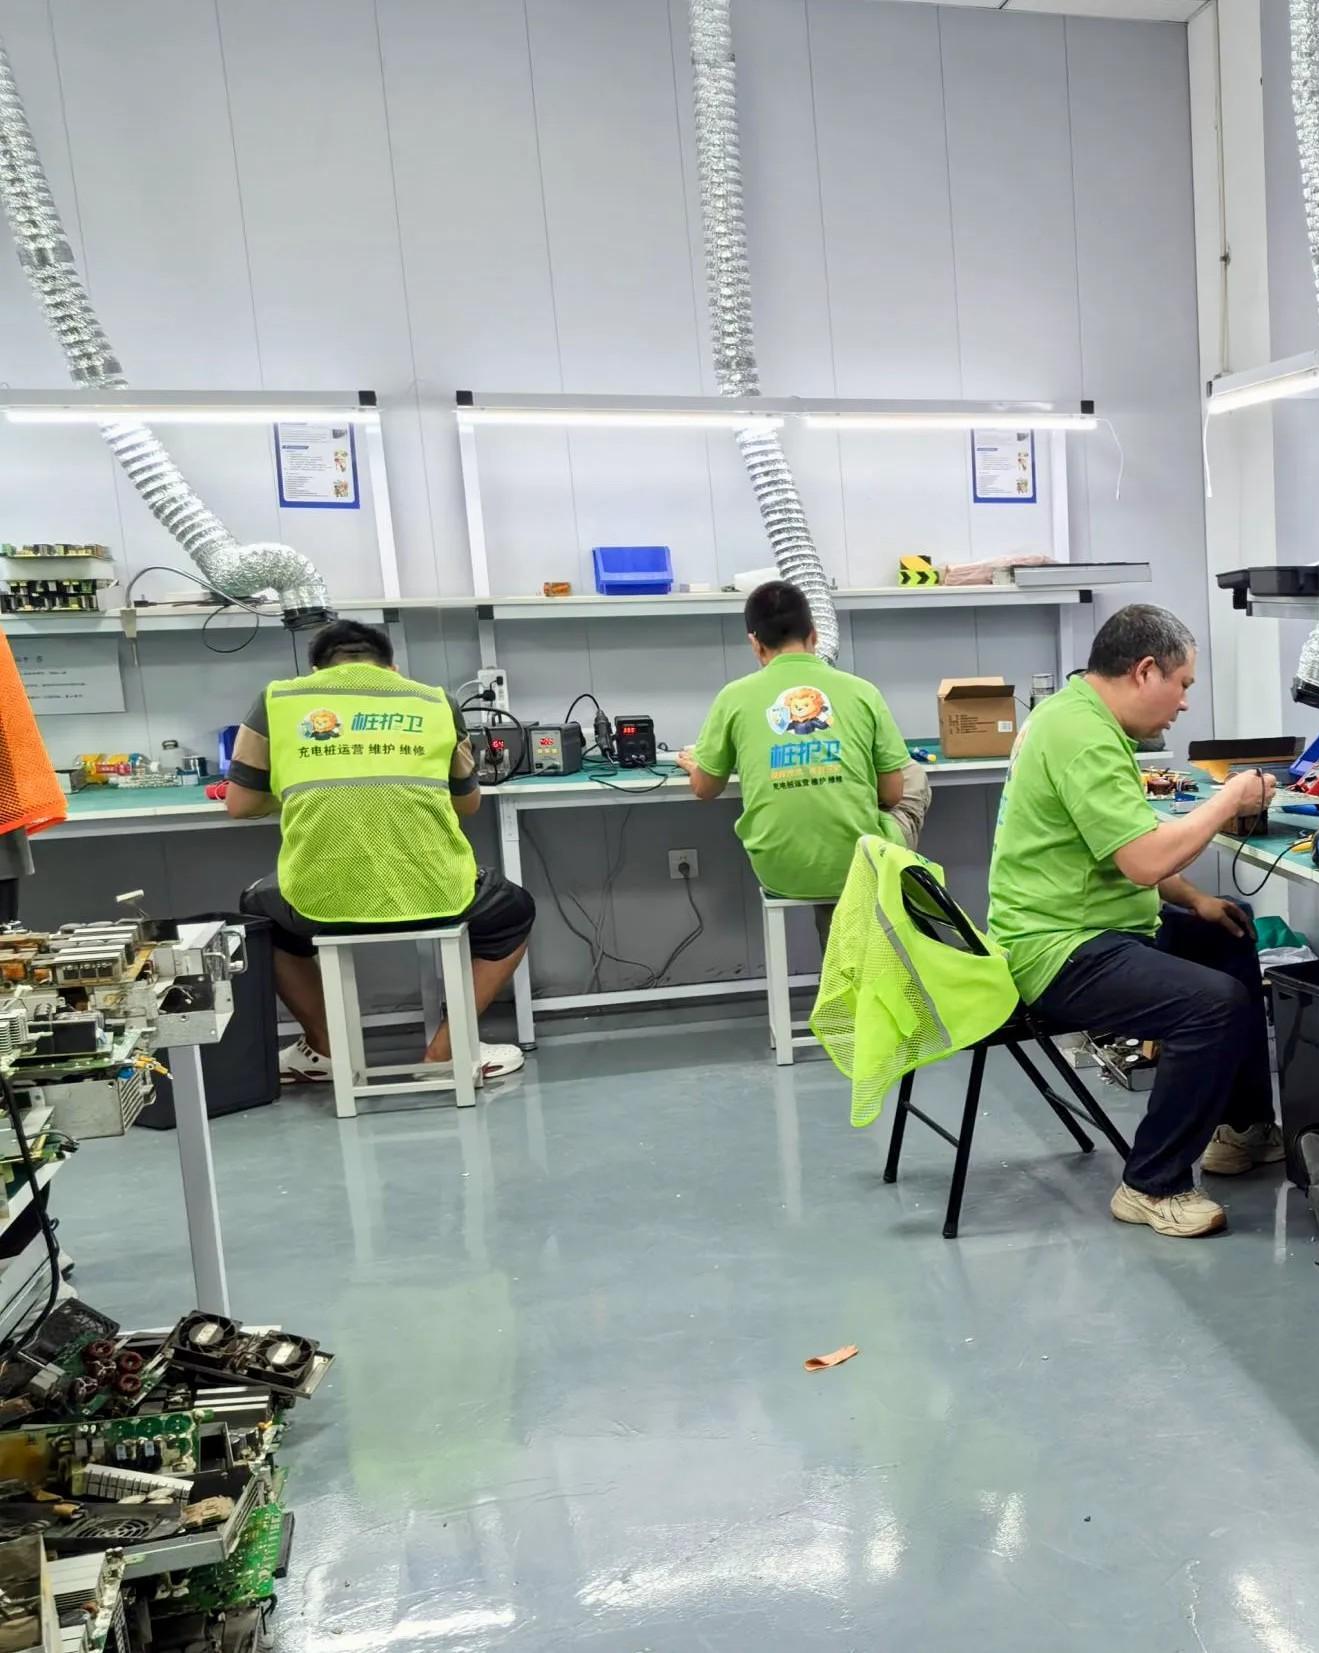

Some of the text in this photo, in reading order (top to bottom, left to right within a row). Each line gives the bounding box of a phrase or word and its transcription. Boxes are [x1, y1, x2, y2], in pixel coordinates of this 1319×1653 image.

[352, 712, 423, 733] 桩护卫
[298, 742, 426, 759] 充电桩运营 维护 维修
